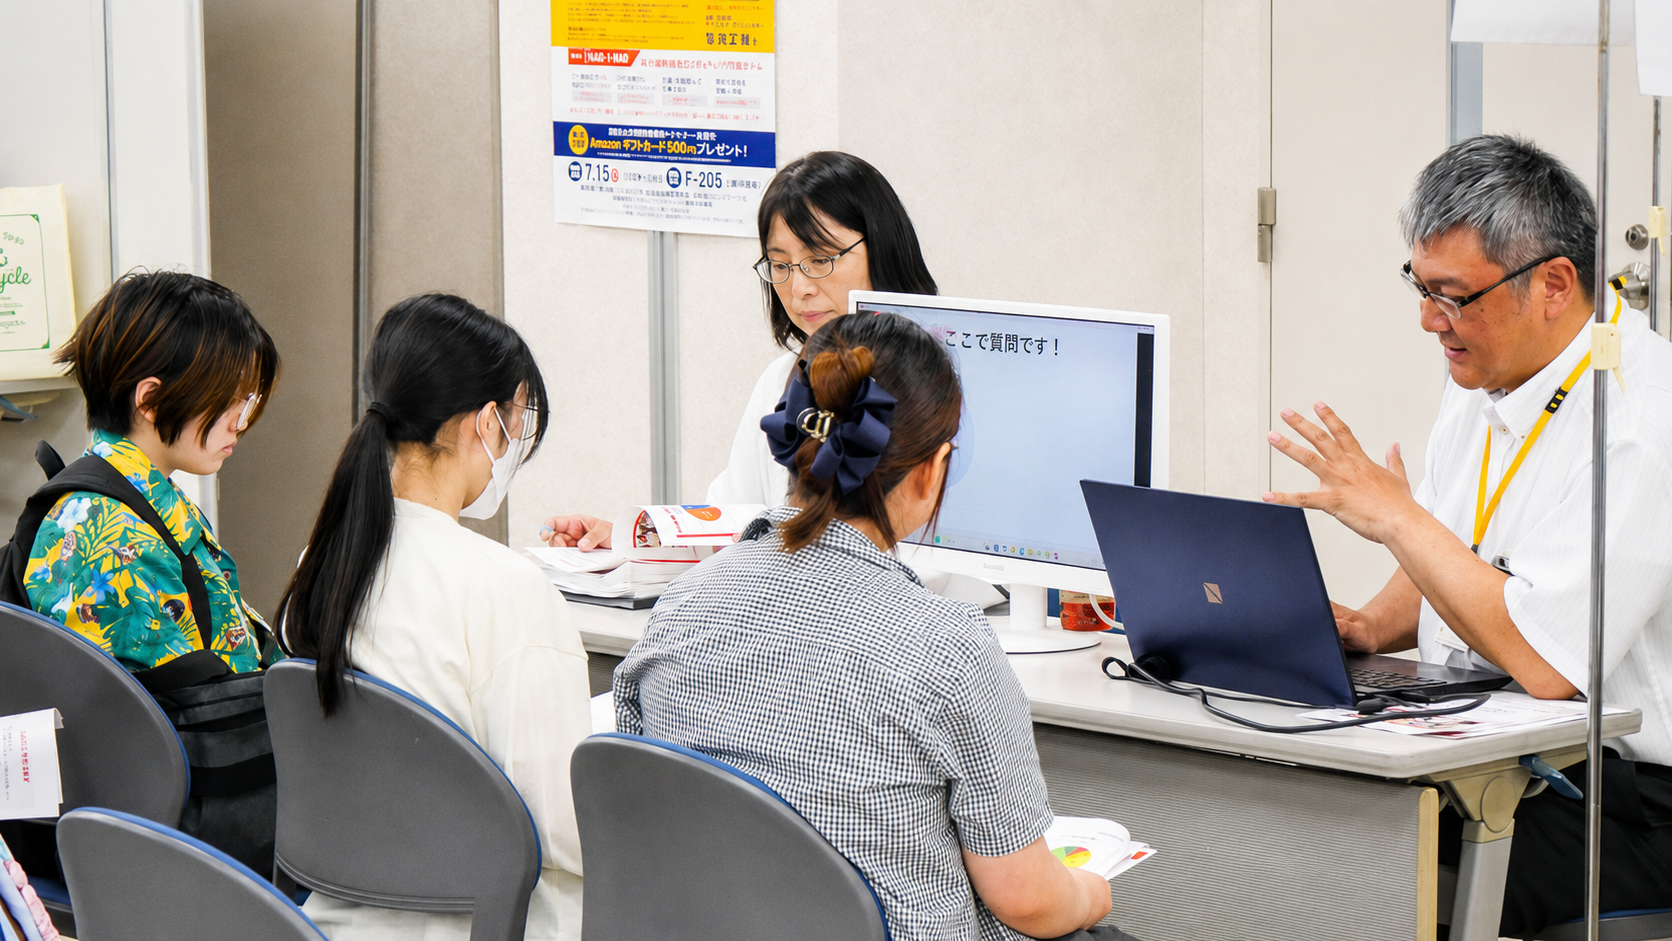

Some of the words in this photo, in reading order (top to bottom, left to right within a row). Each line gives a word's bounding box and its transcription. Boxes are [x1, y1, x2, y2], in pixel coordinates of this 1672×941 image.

[590, 137, 621, 150] Amazon
[686, 171, 722, 189] F-205
[945, 330, 1058, 356] ここで質問です！
